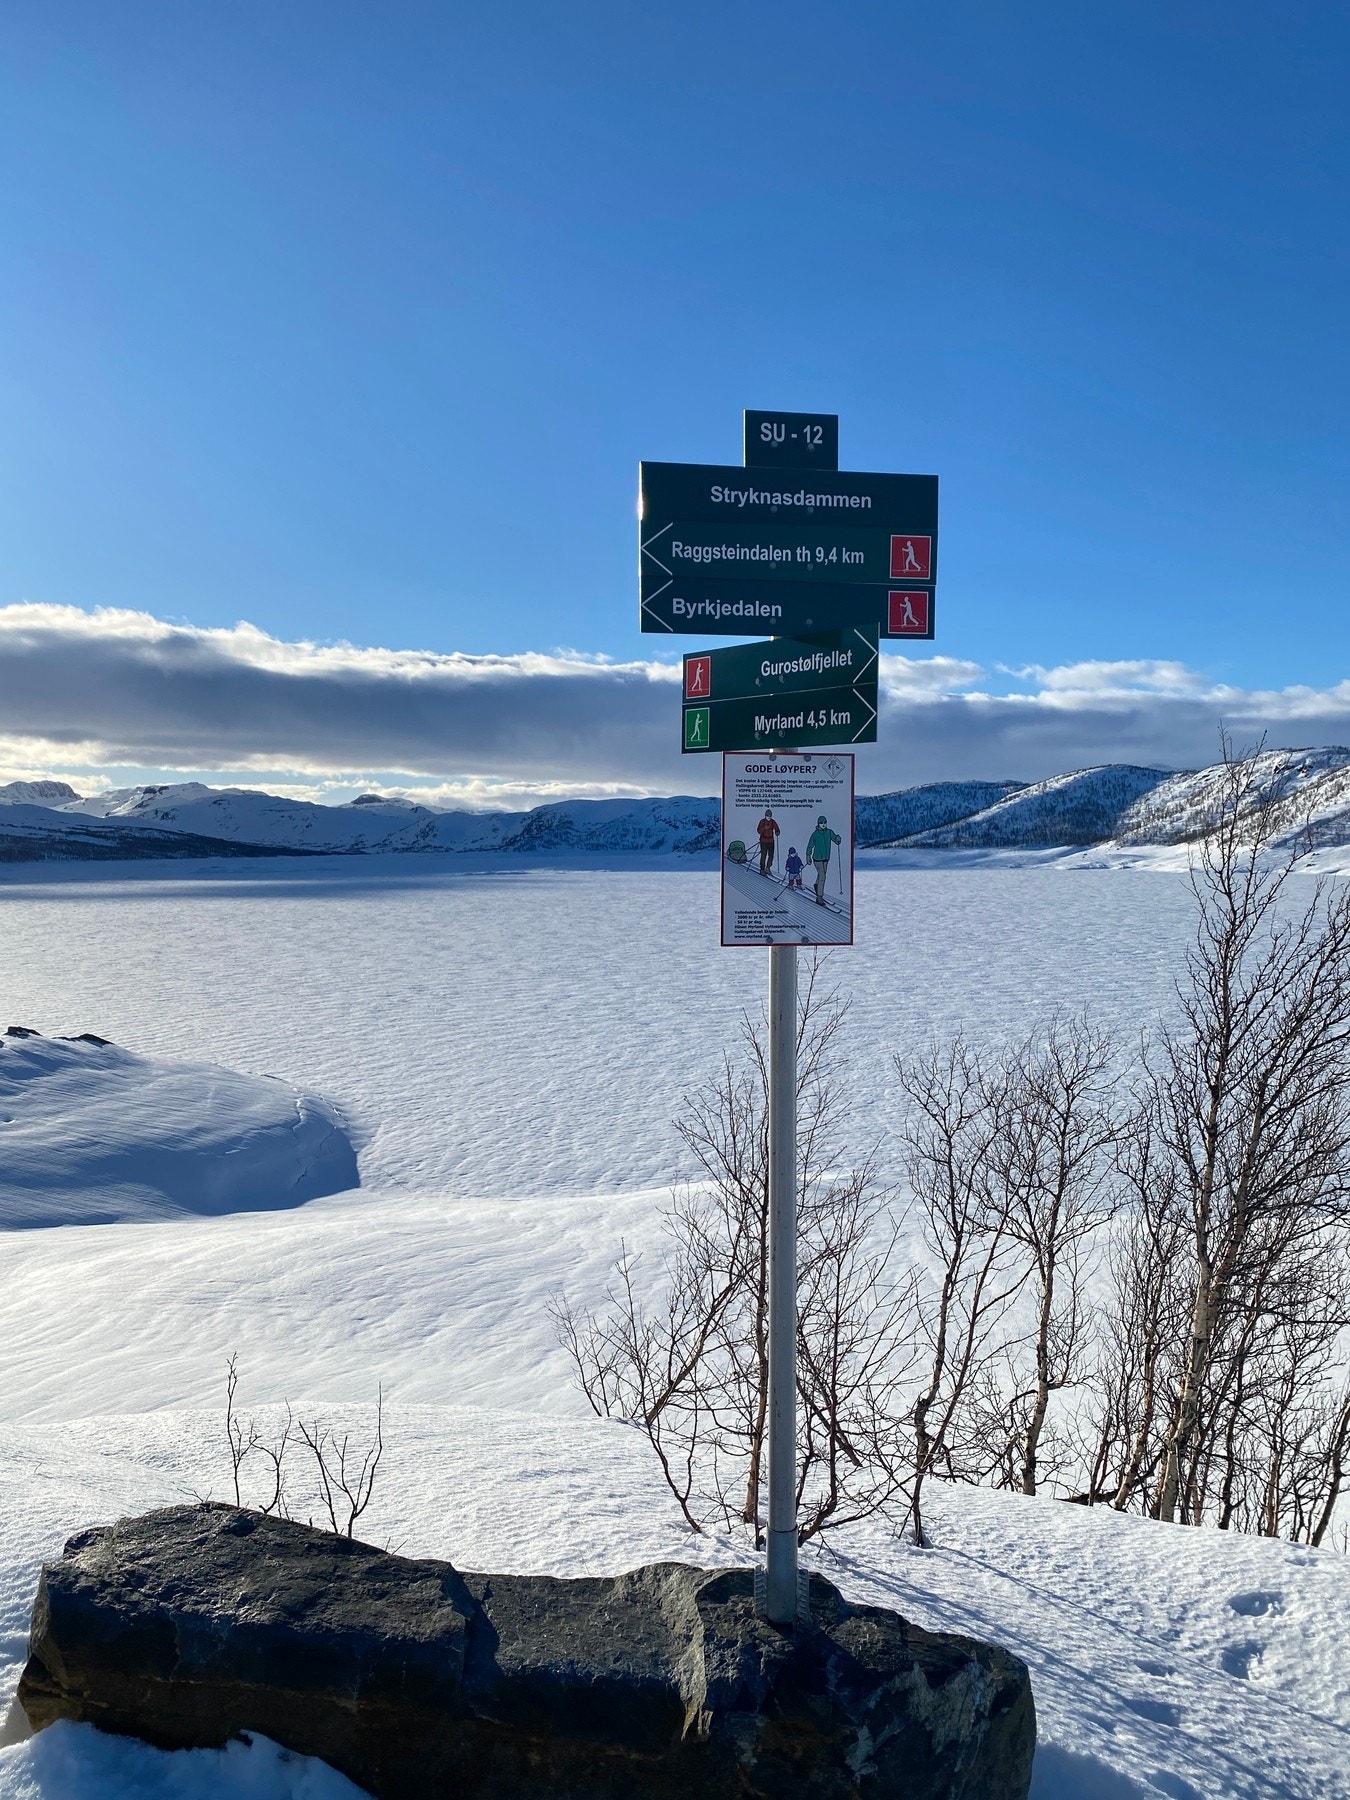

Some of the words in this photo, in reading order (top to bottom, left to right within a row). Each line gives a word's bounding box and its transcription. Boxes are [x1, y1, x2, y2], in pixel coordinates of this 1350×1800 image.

[760, 422, 785, 442] SU
[803, 425, 823, 444] 12
[710, 486, 872, 508] Stryknasdammen
[671, 541, 791, 563] Raggsteindalen
[796, 546, 811, 562] th
[815, 547, 838, 565] 9,4
[842, 548, 864, 564] km
[672, 598, 782, 619] Byrkjedalen
[761, 649, 852, 676] Gurostølfjellet
[754, 712, 804, 734] Myrland
[807, 710, 827, 729] 4,5
[830, 708, 851, 725] km
[745, 764, 772, 773] GODE
[775, 765, 817, 774] LØYPER?
